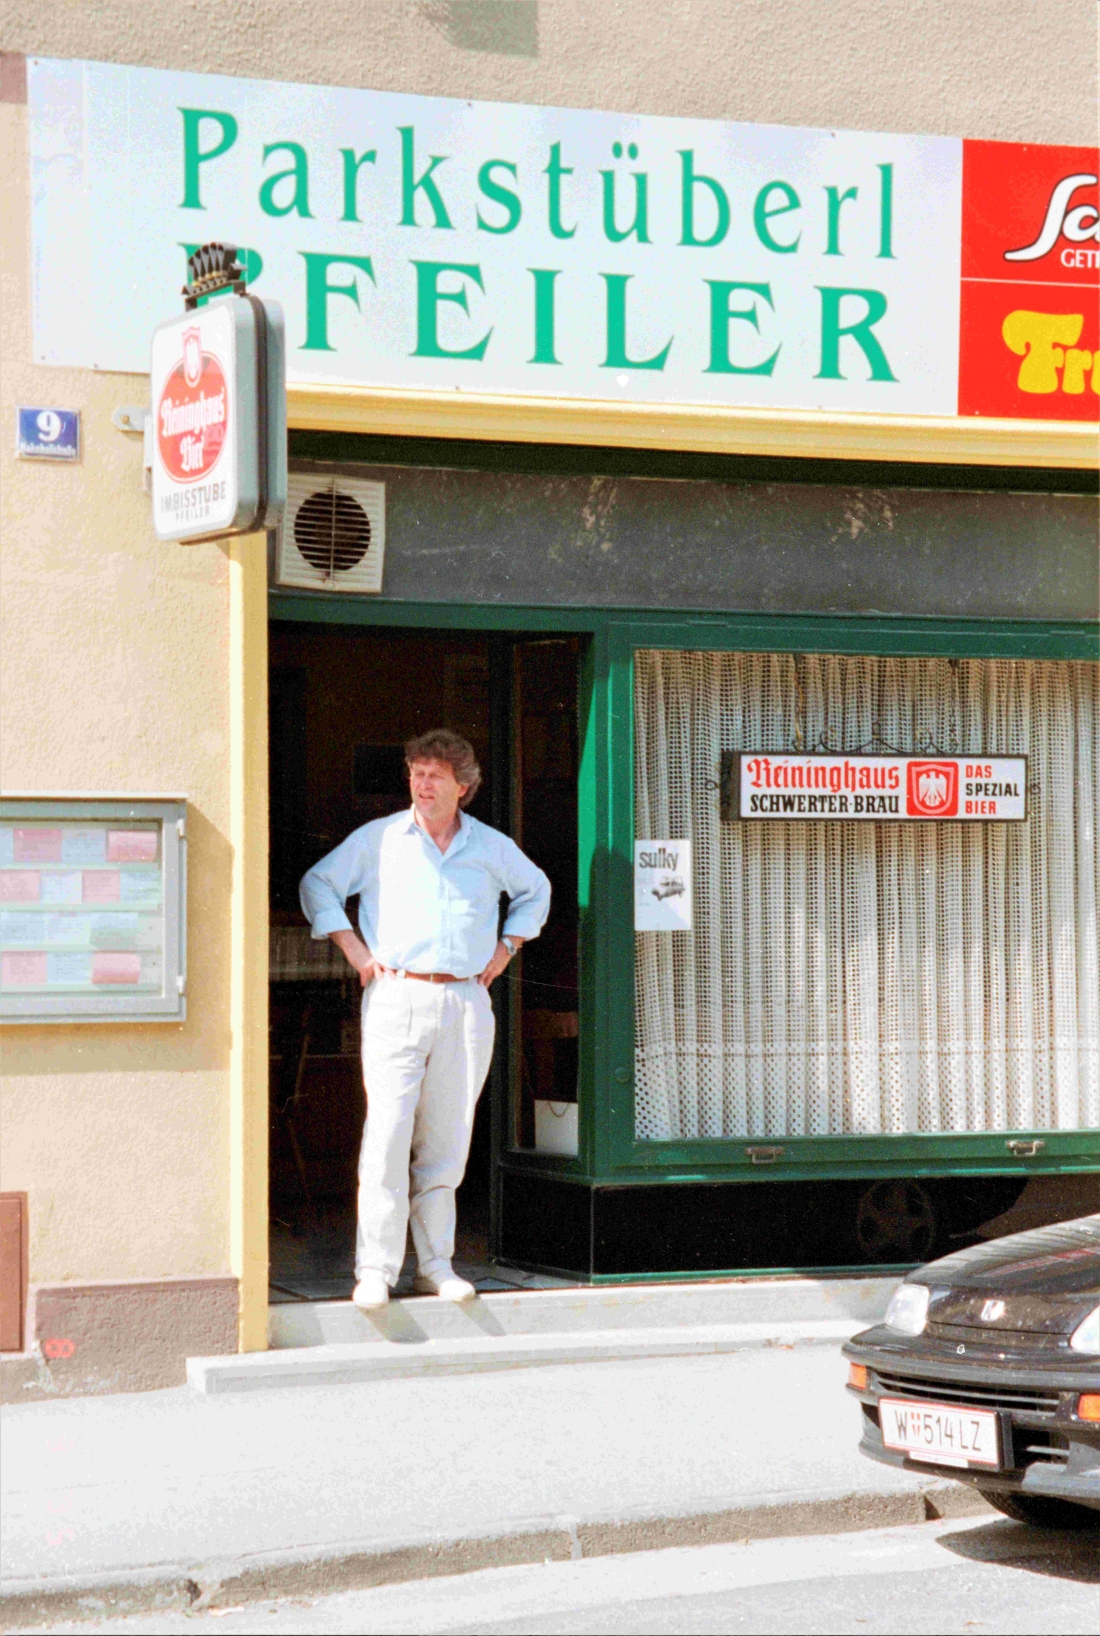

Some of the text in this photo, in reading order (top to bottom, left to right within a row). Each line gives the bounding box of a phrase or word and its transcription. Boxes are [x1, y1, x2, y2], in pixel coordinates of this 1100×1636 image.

[177, 107, 896, 259] Parkstüberl
[36, 410, 62, 443] 9
[161, 481, 226, 513] IMBISSTUBE
[746, 757, 900, 794] Reininghaus
[965, 764, 993, 779] DAS
[965, 782, 1020, 797] SPEZIAL
[965, 800, 997, 815] BIER
[638, 847, 679, 872] sulky
[894, 1410, 908, 1442] W
